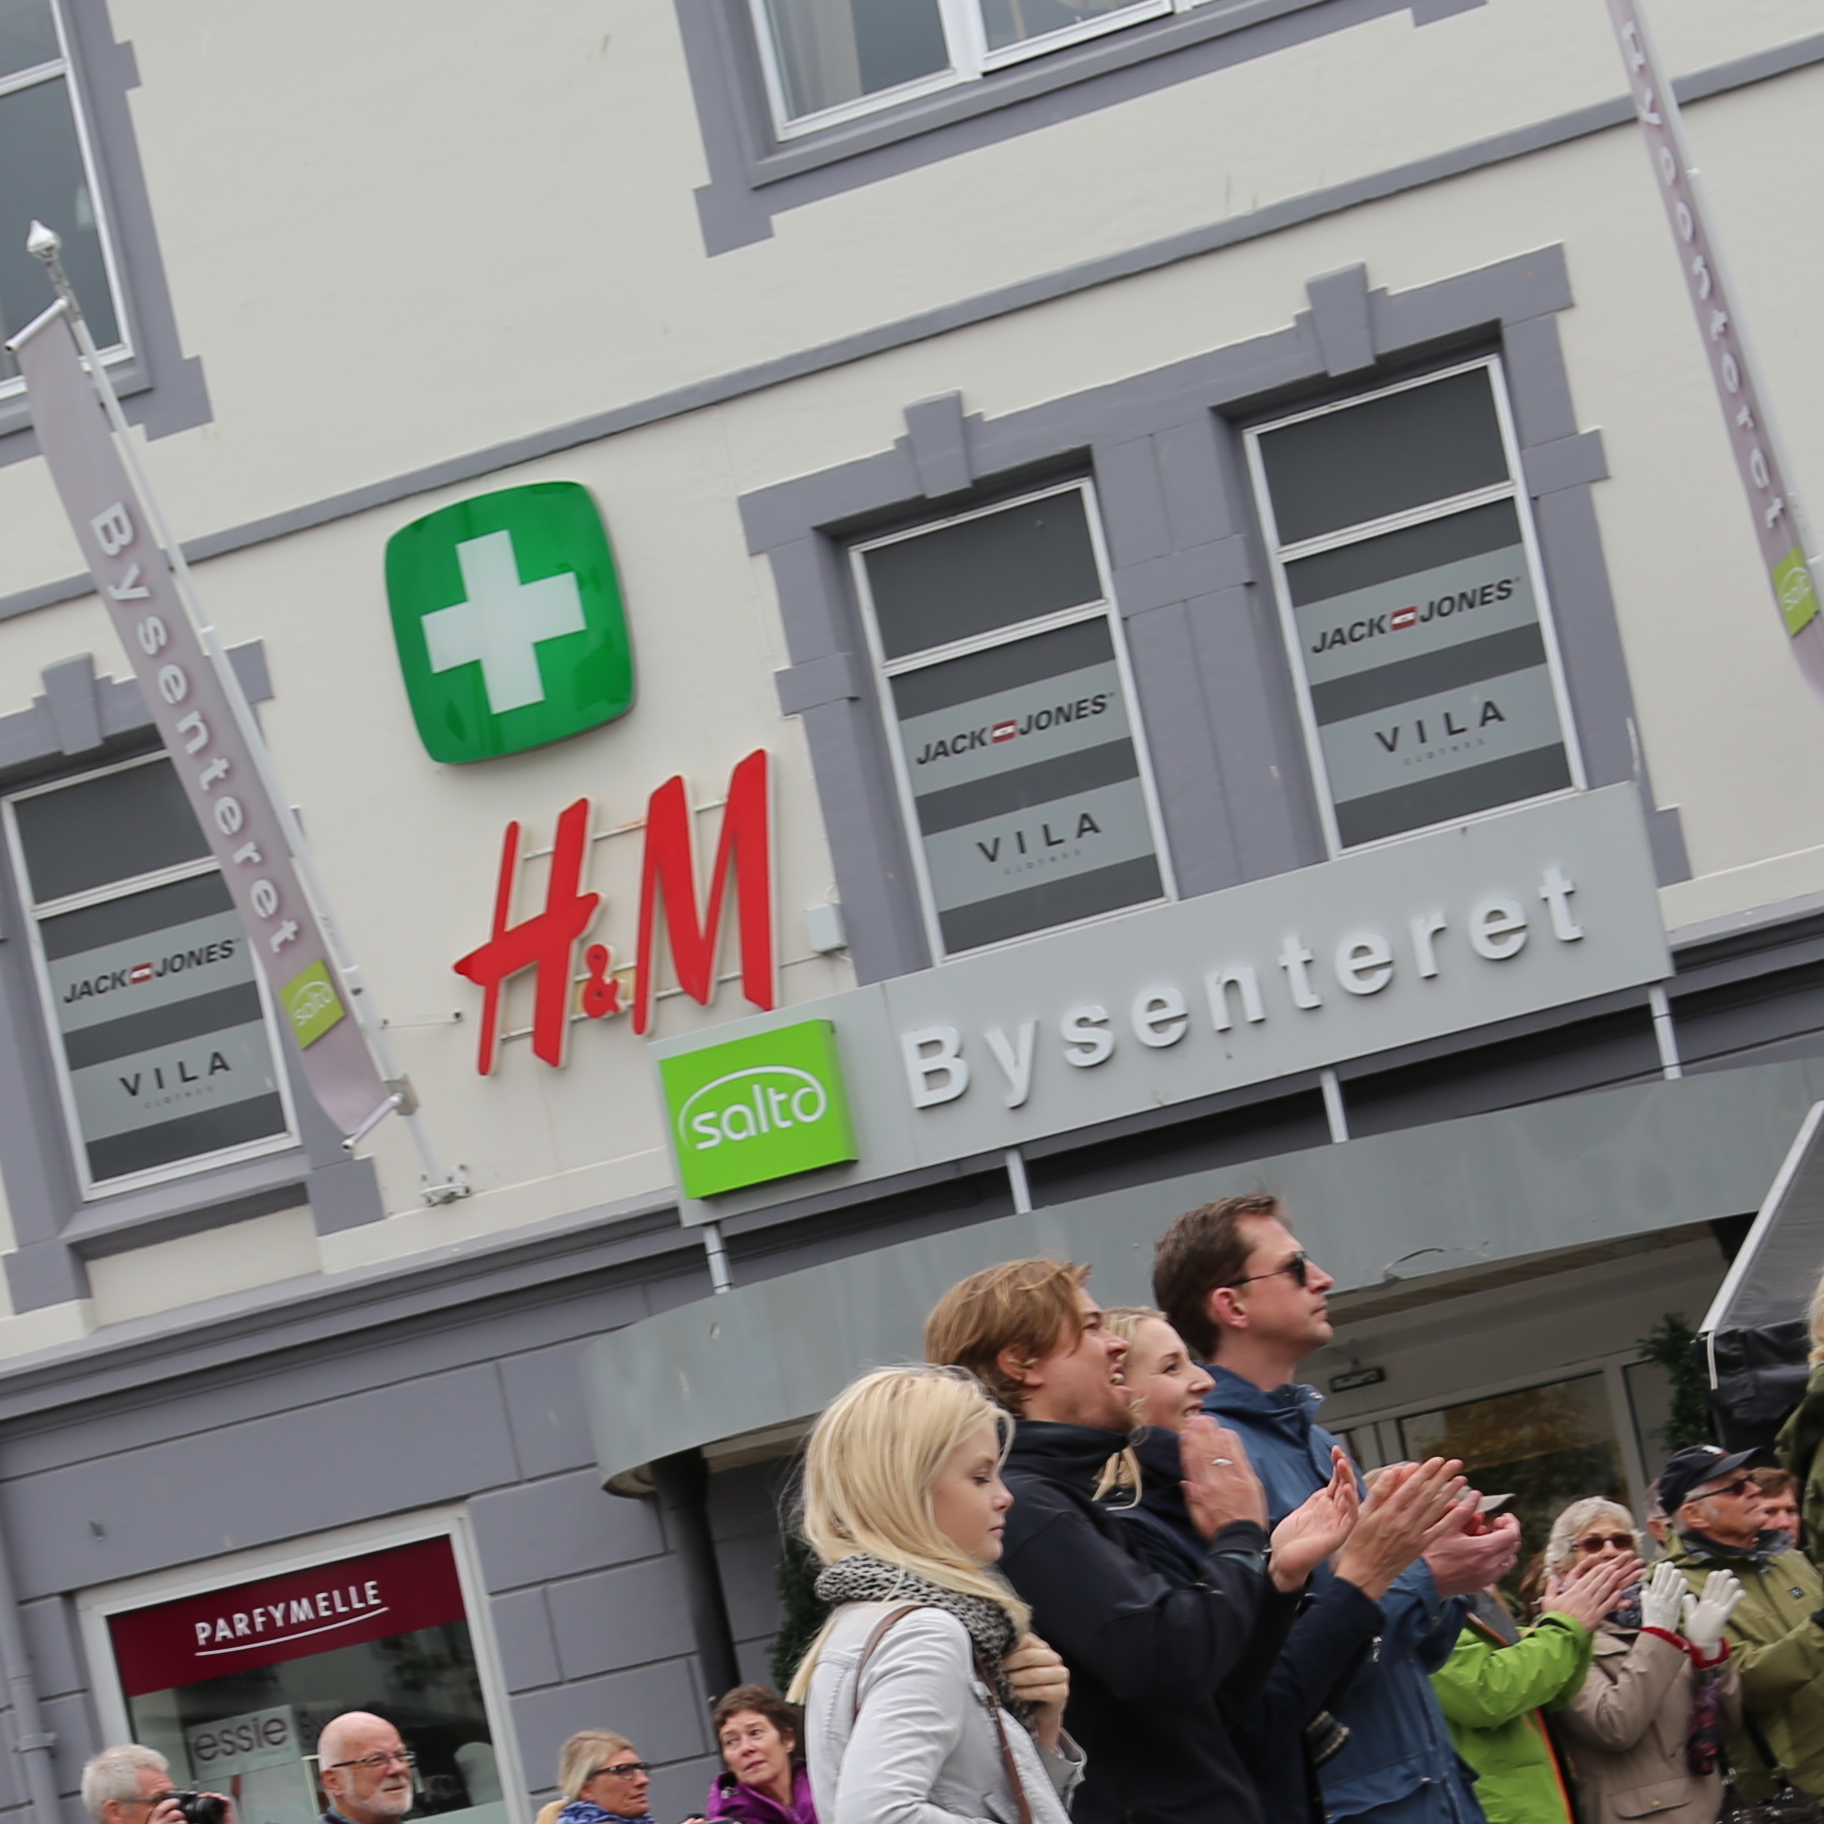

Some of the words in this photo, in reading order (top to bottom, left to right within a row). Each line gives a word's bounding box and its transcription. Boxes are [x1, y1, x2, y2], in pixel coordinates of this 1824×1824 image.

[1311, 614, 1389, 654] JACK
[1418, 578, 1514, 623] JONES
[90, 501, 300, 954] Bysenteret
[915, 726, 989, 765] JACK
[1018, 693, 1109, 736] JONES
[1374, 700, 1506, 752] VILA
[976, 812, 1102, 862] VILA
[452, 748, 774, 1076] H&M
[63, 968, 128, 1004] JACK
[155, 939, 236, 978] JONES
[899, 864, 1584, 1110] Bysenteret
[119, 1051, 232, 1097] VILA
[690, 1082, 828, 1150] salto
[194, 1580, 382, 1646] PARFYMELLE
[194, 1716, 288, 1762] essie
